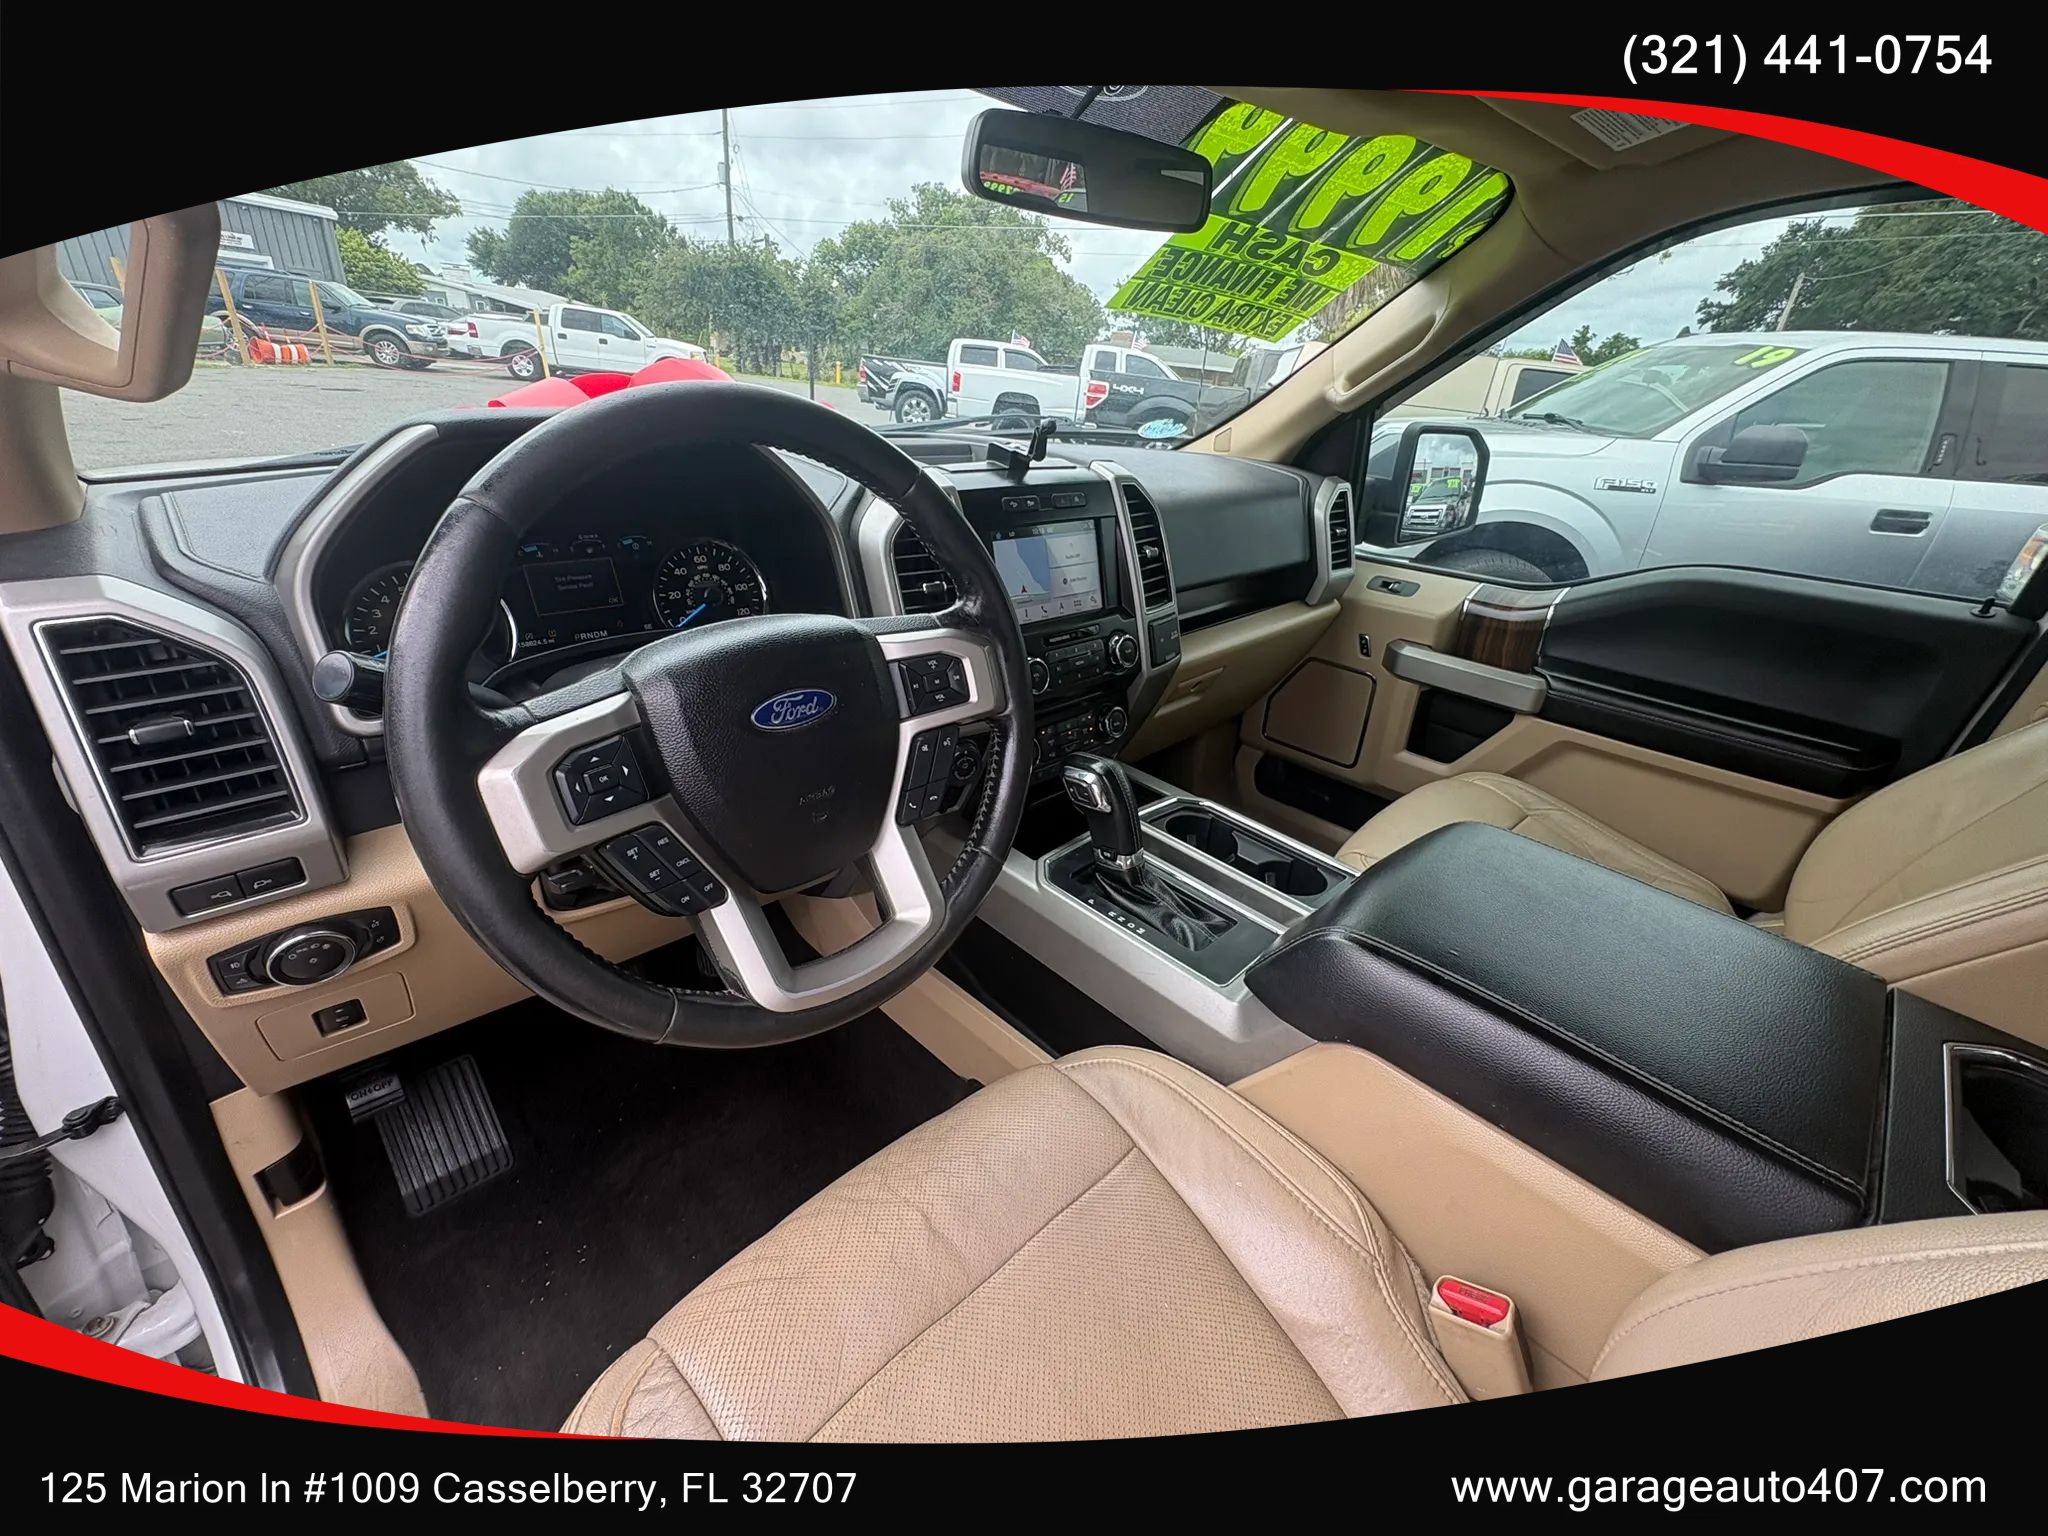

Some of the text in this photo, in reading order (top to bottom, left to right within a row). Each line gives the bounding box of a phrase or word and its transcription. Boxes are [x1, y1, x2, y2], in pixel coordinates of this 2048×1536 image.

[1733, 345, 1795, 369] 19
[693, 555, 707, 564] 60
[673, 567, 688, 576] 40
[717, 563, 731, 572] 80
[734, 583, 748, 592] 100
[380, 595, 391, 604] 4
[667, 590, 682, 600] 20
[371, 608, 382, 618] 3
[736, 607, 751, 616] 120
[368, 625, 379, 635] 2
[770, 694, 819, 724] Ford
[599, 775, 609, 783] OK
[657, 837, 669, 847] RES
[626, 847, 639, 857] SET
[676, 857, 691, 868] CNCL
[649, 869, 661, 879] SET
[703, 882, 714, 892] OFF
[680, 895, 690, 904] ON
[351, 1078, 393, 1101] ON OFF
